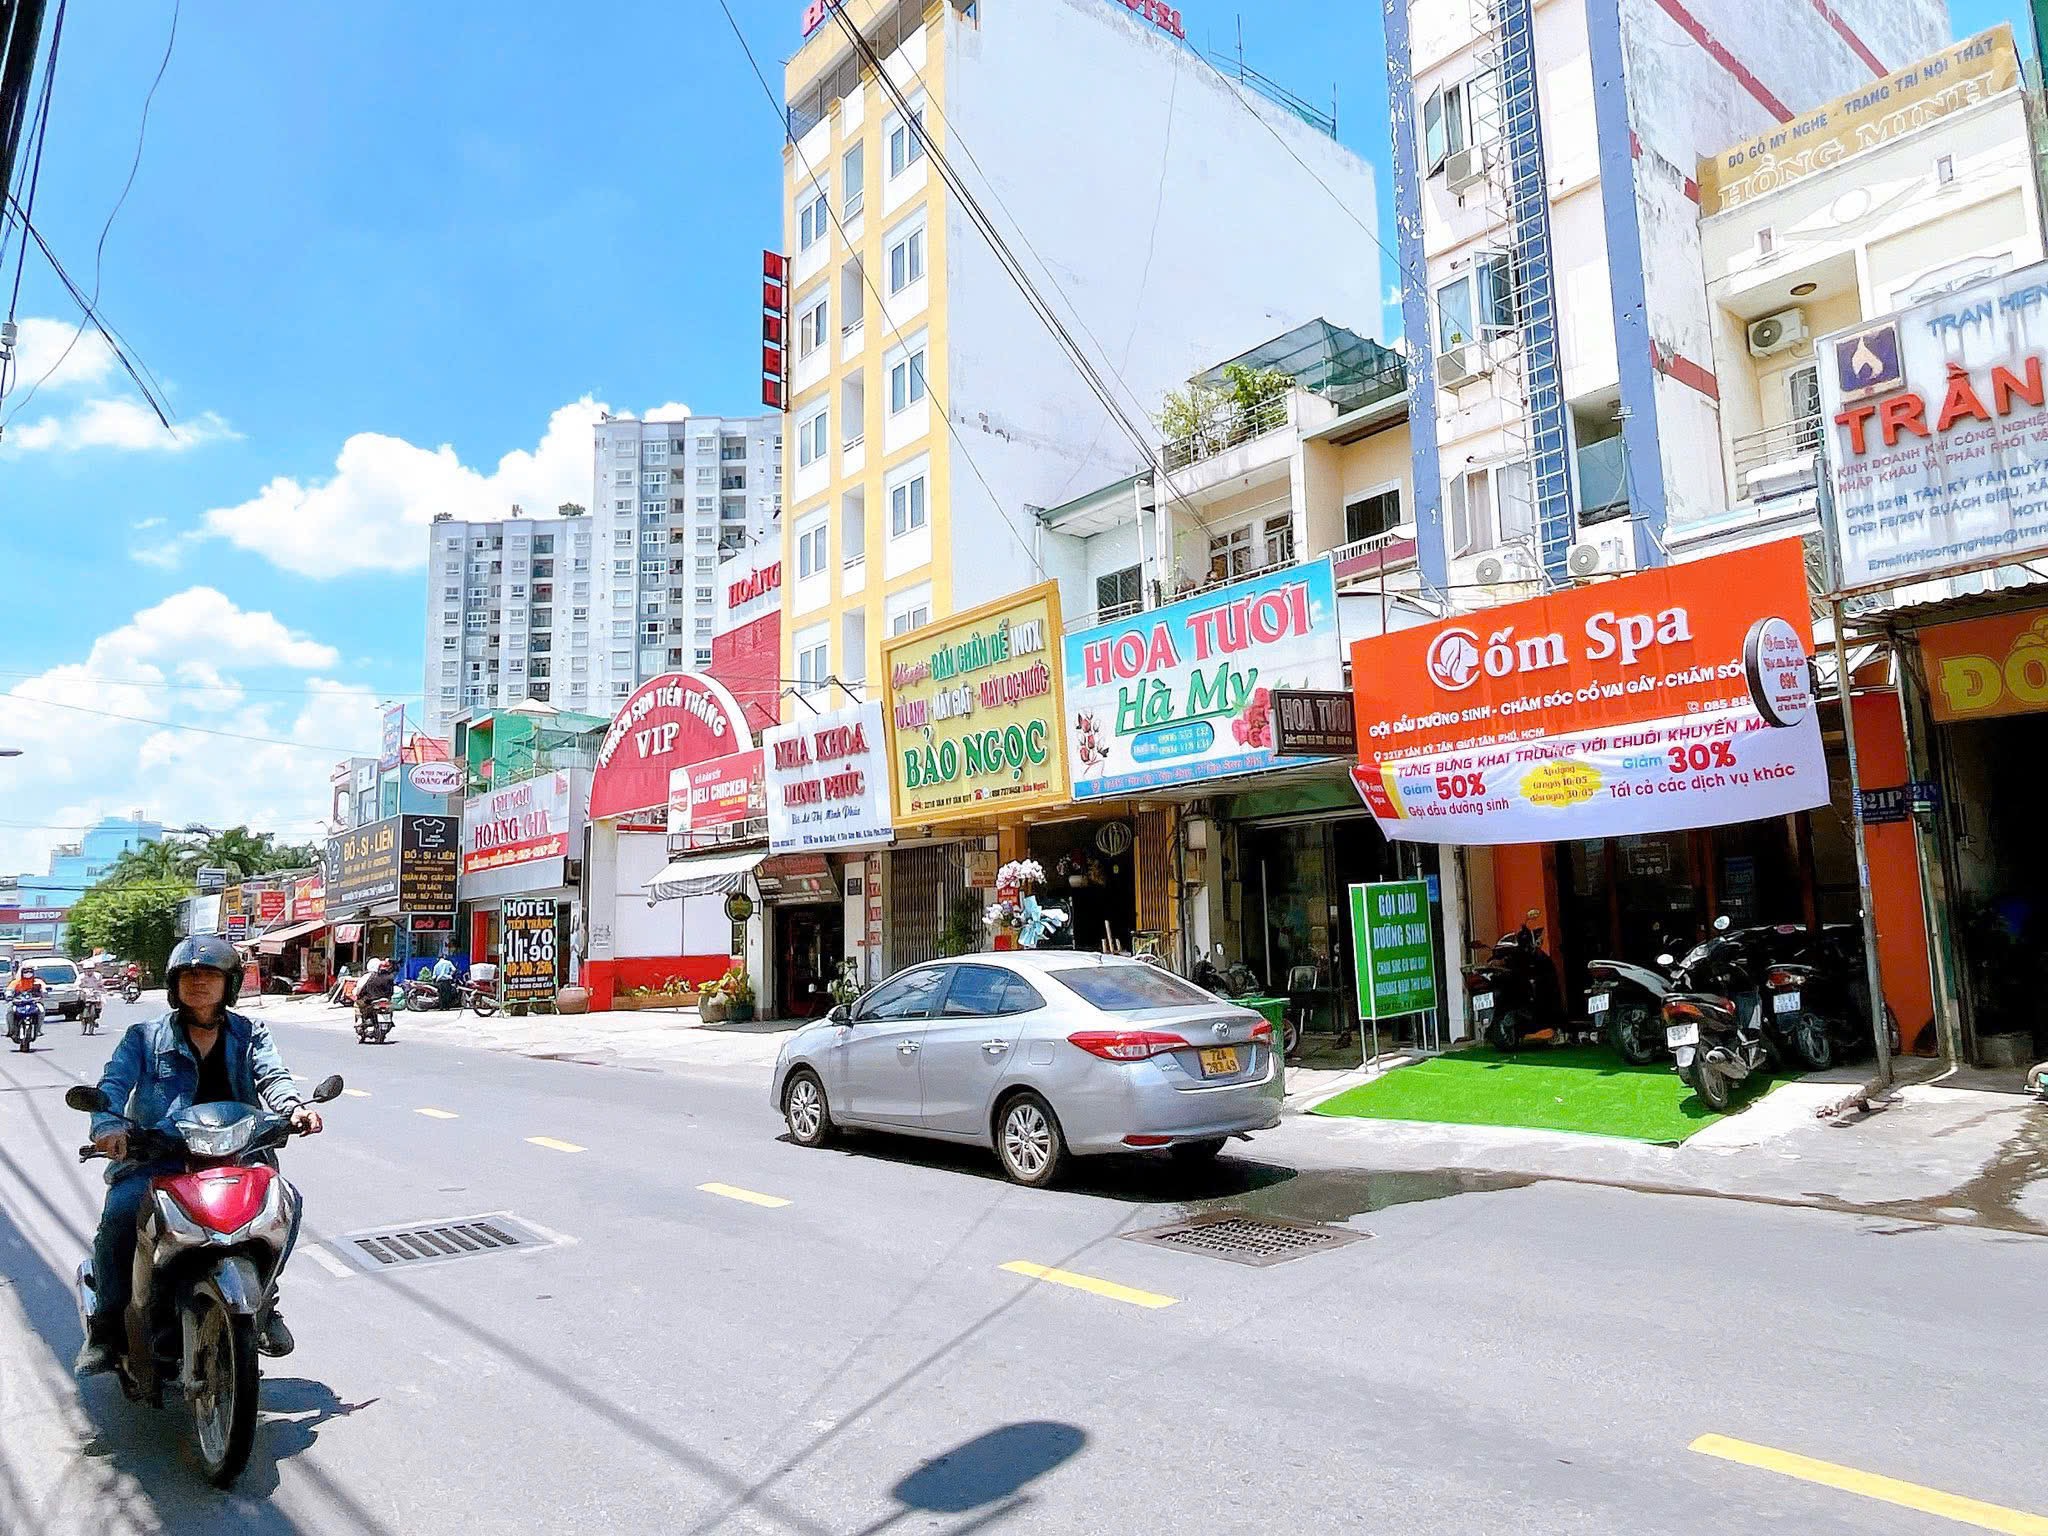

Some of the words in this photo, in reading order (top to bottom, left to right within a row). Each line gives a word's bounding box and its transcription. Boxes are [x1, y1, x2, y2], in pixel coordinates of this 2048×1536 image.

[1845, 86, 1890, 115] TRANG
[1855, 70, 1995, 154] MINH
[763, 251, 782, 406] HOTEL
[1838, 462, 1867, 478] KINH
[1872, 449, 1920, 469] DOANH
[1954, 428, 1996, 446] CÔNG
[1945, 447, 1985, 465] PHÂN
[1913, 484, 1942, 501] TÂN
[1974, 468, 2006, 486] TÂN
[1082, 620, 1182, 689] HOA
[1186, 580, 1314, 662] TƯƠI
[1585, 606, 1695, 666] Spa
[656, 676, 683, 707] TIẾN
[684, 688, 728, 737] THẮNG
[980, 674, 1000, 709] MÁY
[1115, 678, 1176, 735] Hà
[1461, 704, 1491, 722] SINH
[1500, 695, 1542, 716] CHĂM
[1544, 689, 1573, 707] SÓC
[1576, 679, 1599, 702] CỔ
[1601, 681, 1624, 698] VAI
[1627, 674, 1657, 694] GÁY
[1665, 664, 1714, 687] CHĂM
[1717, 657, 1744, 680] SÓ
[1280, 698, 1315, 731] HOA
[635, 722, 680, 759] VIP
[773, 736, 813, 770] NHA
[814, 722, 870, 762] KHOA
[905, 725, 958, 788] BẢO
[962, 719, 1047, 780] NGỌC
[1405, 744, 1421, 757] TÂN
[1436, 740, 1455, 754] TÂN
[1521, 727, 1546, 741] HCM
[1478, 752, 1511, 768] KHAI
[1582, 733, 1607, 752] VỚI
[1668, 713, 1739, 741] KHUYẾN
[1668, 740, 1737, 774] 30%
[711, 777, 748, 801] CHICKEN
[823, 763, 866, 801] PHÚC
[1436, 771, 1487, 800] 50%
[1657, 777, 1689, 794] các
[1692, 769, 1722, 793] dịch
[1725, 773, 1749, 789] vụ
[1752, 760, 1796, 784] khác
[1486, 797, 1510, 811] sinh
[475, 812, 518, 849] HOÀNG
[507, 901, 554, 917] HOTEL
[1378, 890, 1396, 919] GỘI
[530, 929, 554, 946] 70
[1405, 922, 1427, 945] SINH
[529, 944, 554, 962] 90
